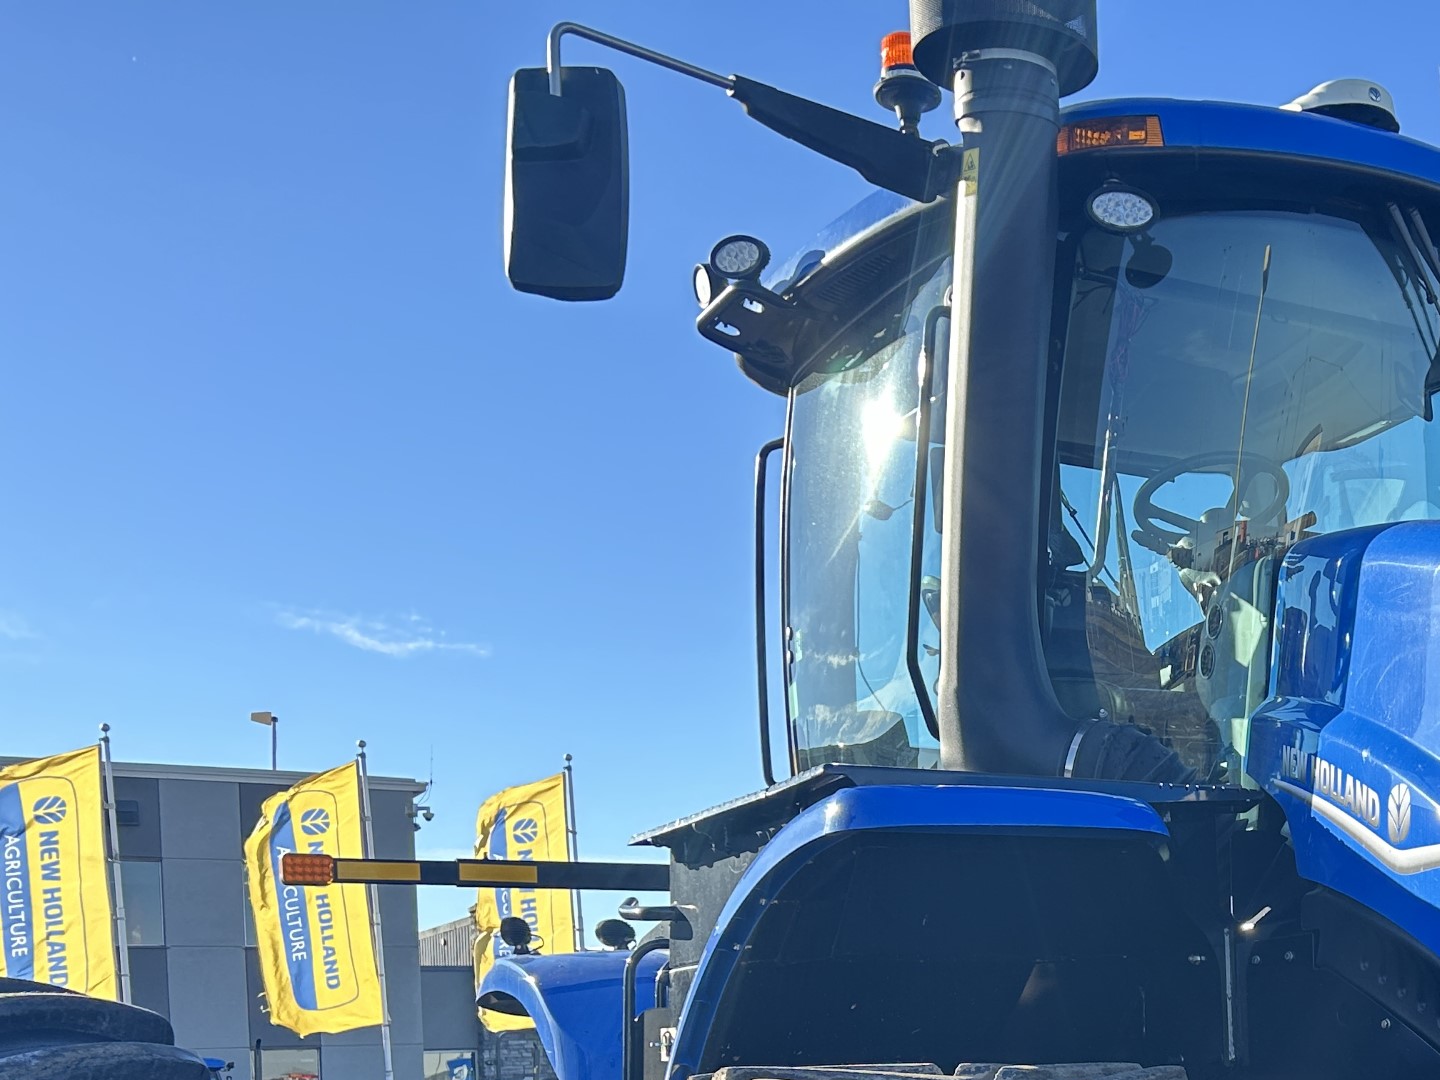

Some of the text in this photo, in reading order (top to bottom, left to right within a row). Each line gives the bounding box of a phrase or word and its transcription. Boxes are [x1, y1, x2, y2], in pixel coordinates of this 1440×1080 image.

[1282, 744, 1380, 829] NEW HOLLAND
[4, 834, 28, 958] AGRICULTURE
[38, 830, 69, 988] NEW HOLLAND
[276, 845, 307, 962] ACULTURE
[315, 893, 341, 990] HOLLAND
